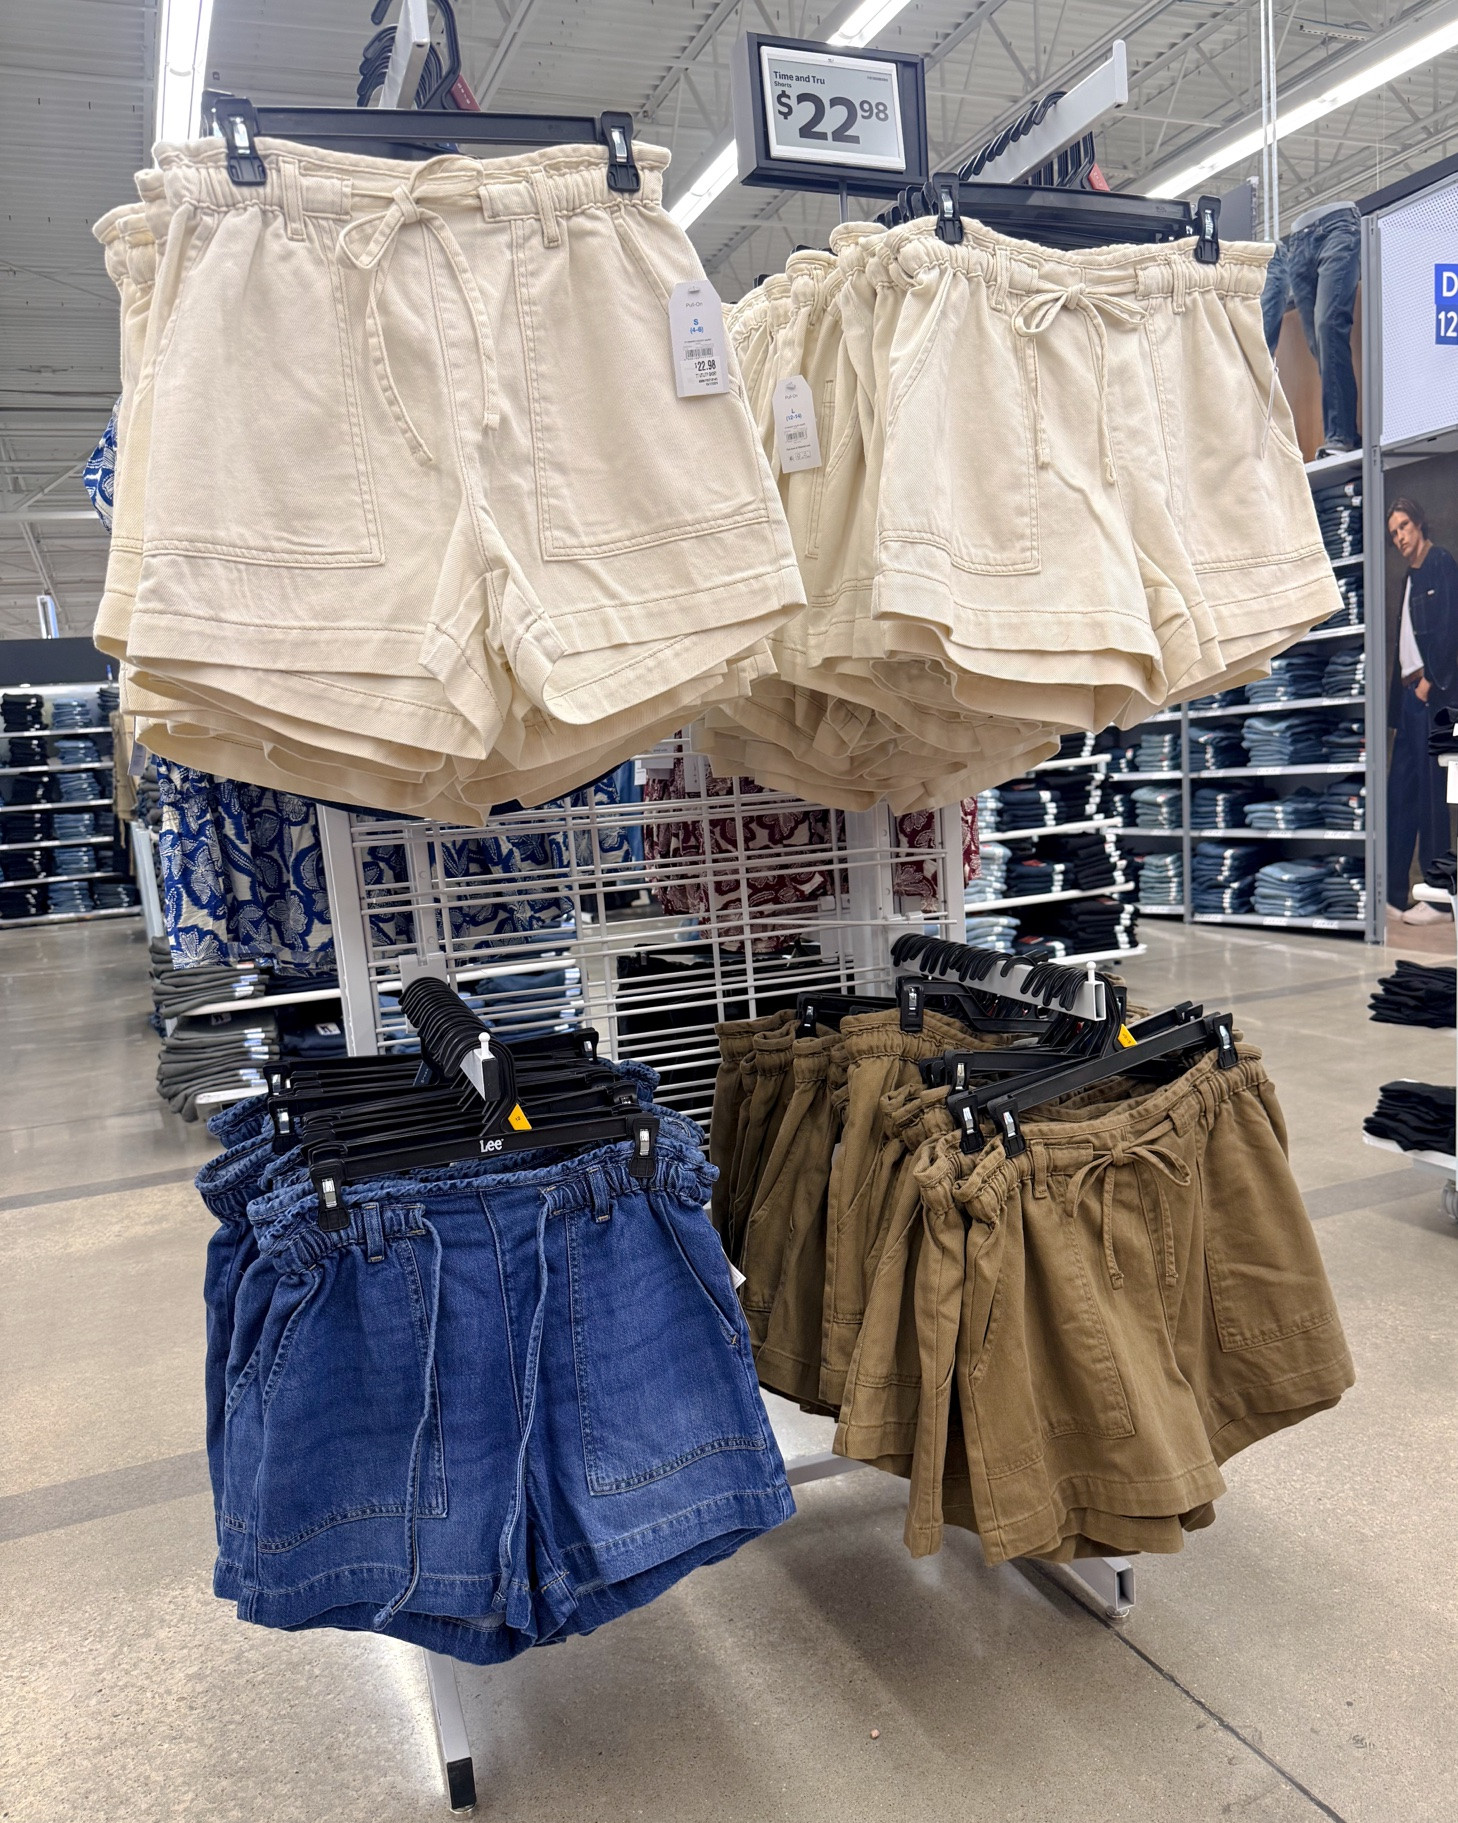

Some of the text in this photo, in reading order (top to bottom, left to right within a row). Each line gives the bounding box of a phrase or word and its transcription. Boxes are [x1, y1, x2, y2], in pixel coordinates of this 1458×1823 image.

[773, 70, 826, 85] Time and Tru
[774, 80, 792, 88] Shorts
[693, 318, 699, 326] S
[1438, 310, 1458, 337] 12
